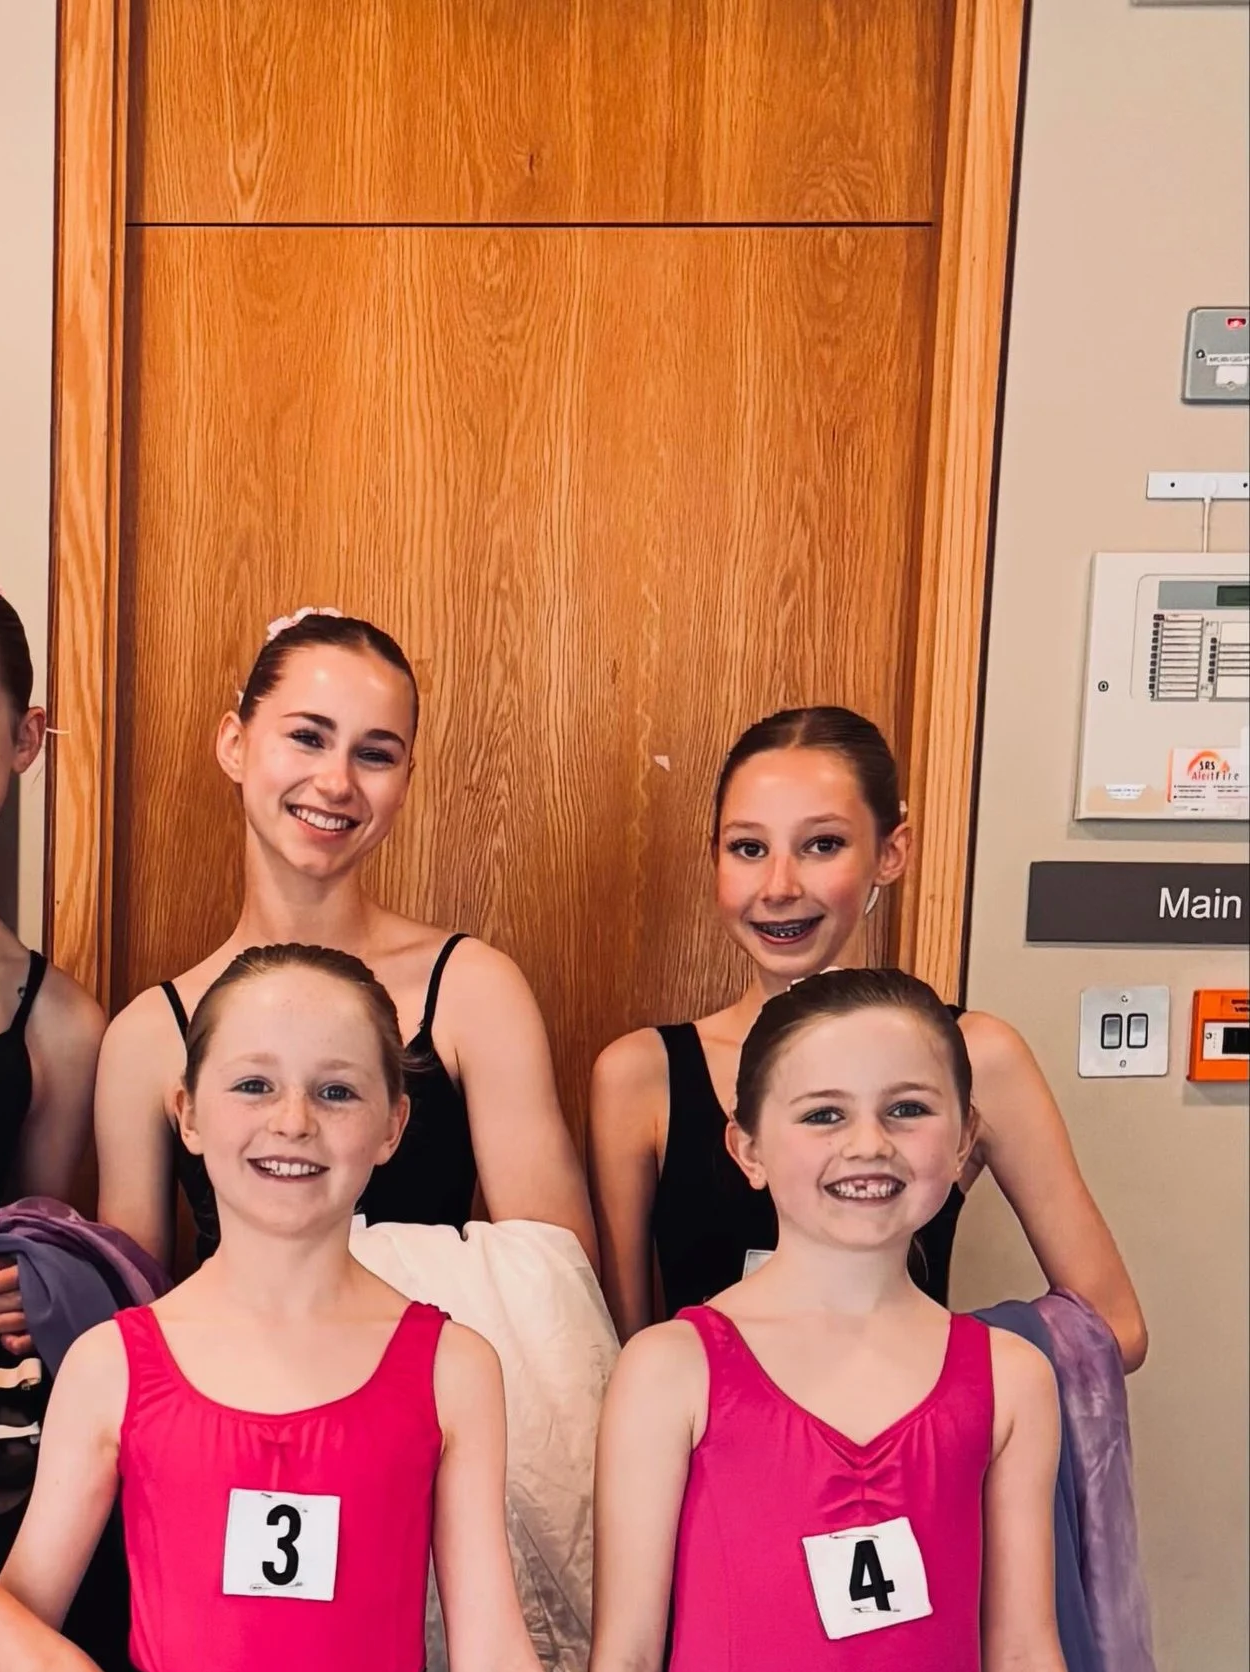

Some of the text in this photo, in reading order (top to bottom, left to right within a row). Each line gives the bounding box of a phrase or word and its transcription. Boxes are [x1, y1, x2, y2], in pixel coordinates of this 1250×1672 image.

[1199, 760, 1216, 770] SRS
[1158, 887, 1242, 919] Main
[261, 1504, 303, 1585] 3
[849, 1539, 896, 1611] 4
